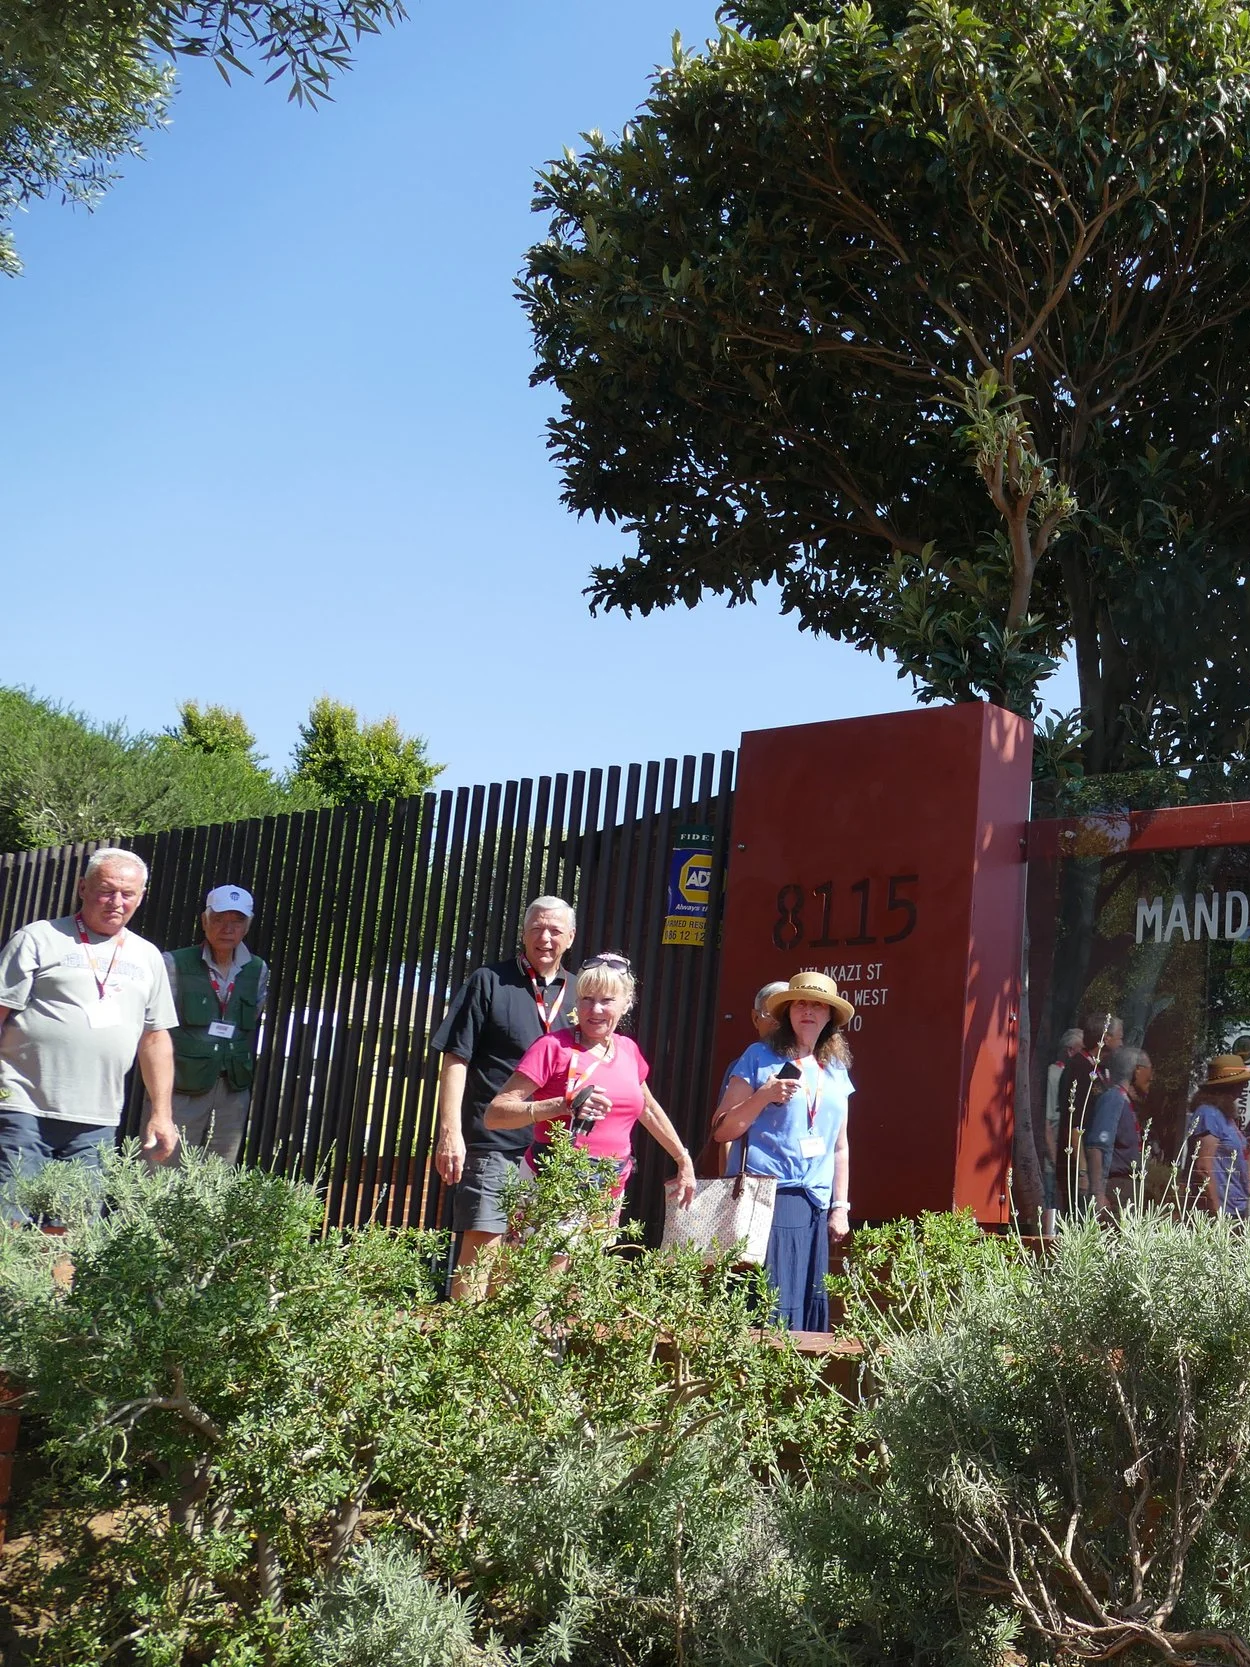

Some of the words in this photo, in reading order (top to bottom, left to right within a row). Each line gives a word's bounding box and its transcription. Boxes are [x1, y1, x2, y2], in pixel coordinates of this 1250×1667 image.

[686, 870, 711, 888] AD
[675, 903, 700, 912] Always
[771, 873, 919, 952] 8115
[680, 931, 691, 941] 12
[866, 963, 883, 981] ST
[854, 988, 888, 1006] WEST
